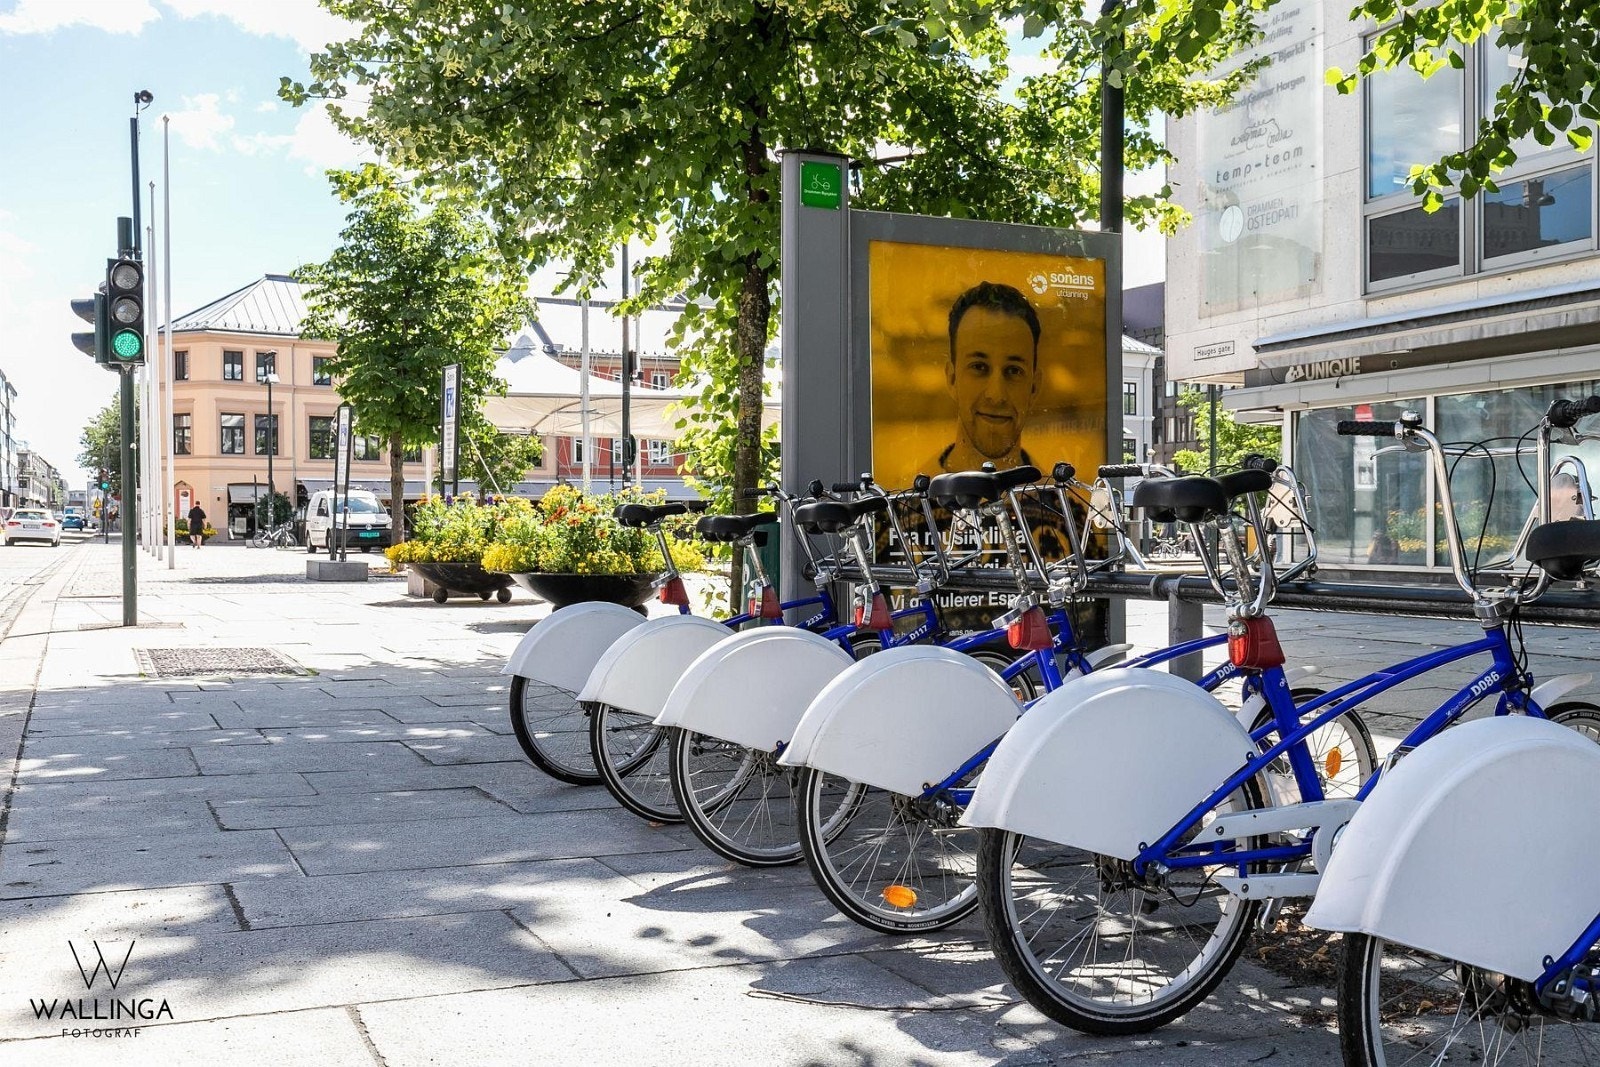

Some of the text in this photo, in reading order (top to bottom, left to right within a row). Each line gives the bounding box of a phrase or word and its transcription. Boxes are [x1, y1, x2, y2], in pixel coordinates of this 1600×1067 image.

[1215, 146, 1303, 184] temp-team
[1247, 204, 1299, 231] OSTEOPATI
[1050, 273, 1095, 285] sonans
[1197, 344, 1231, 357] Hauges gate
[1305, 356, 1361, 381] UNIQUE
[909, 624, 928, 641] D117
[1215, 662, 1237, 679] D08
[1470, 670, 1500, 696] D086
